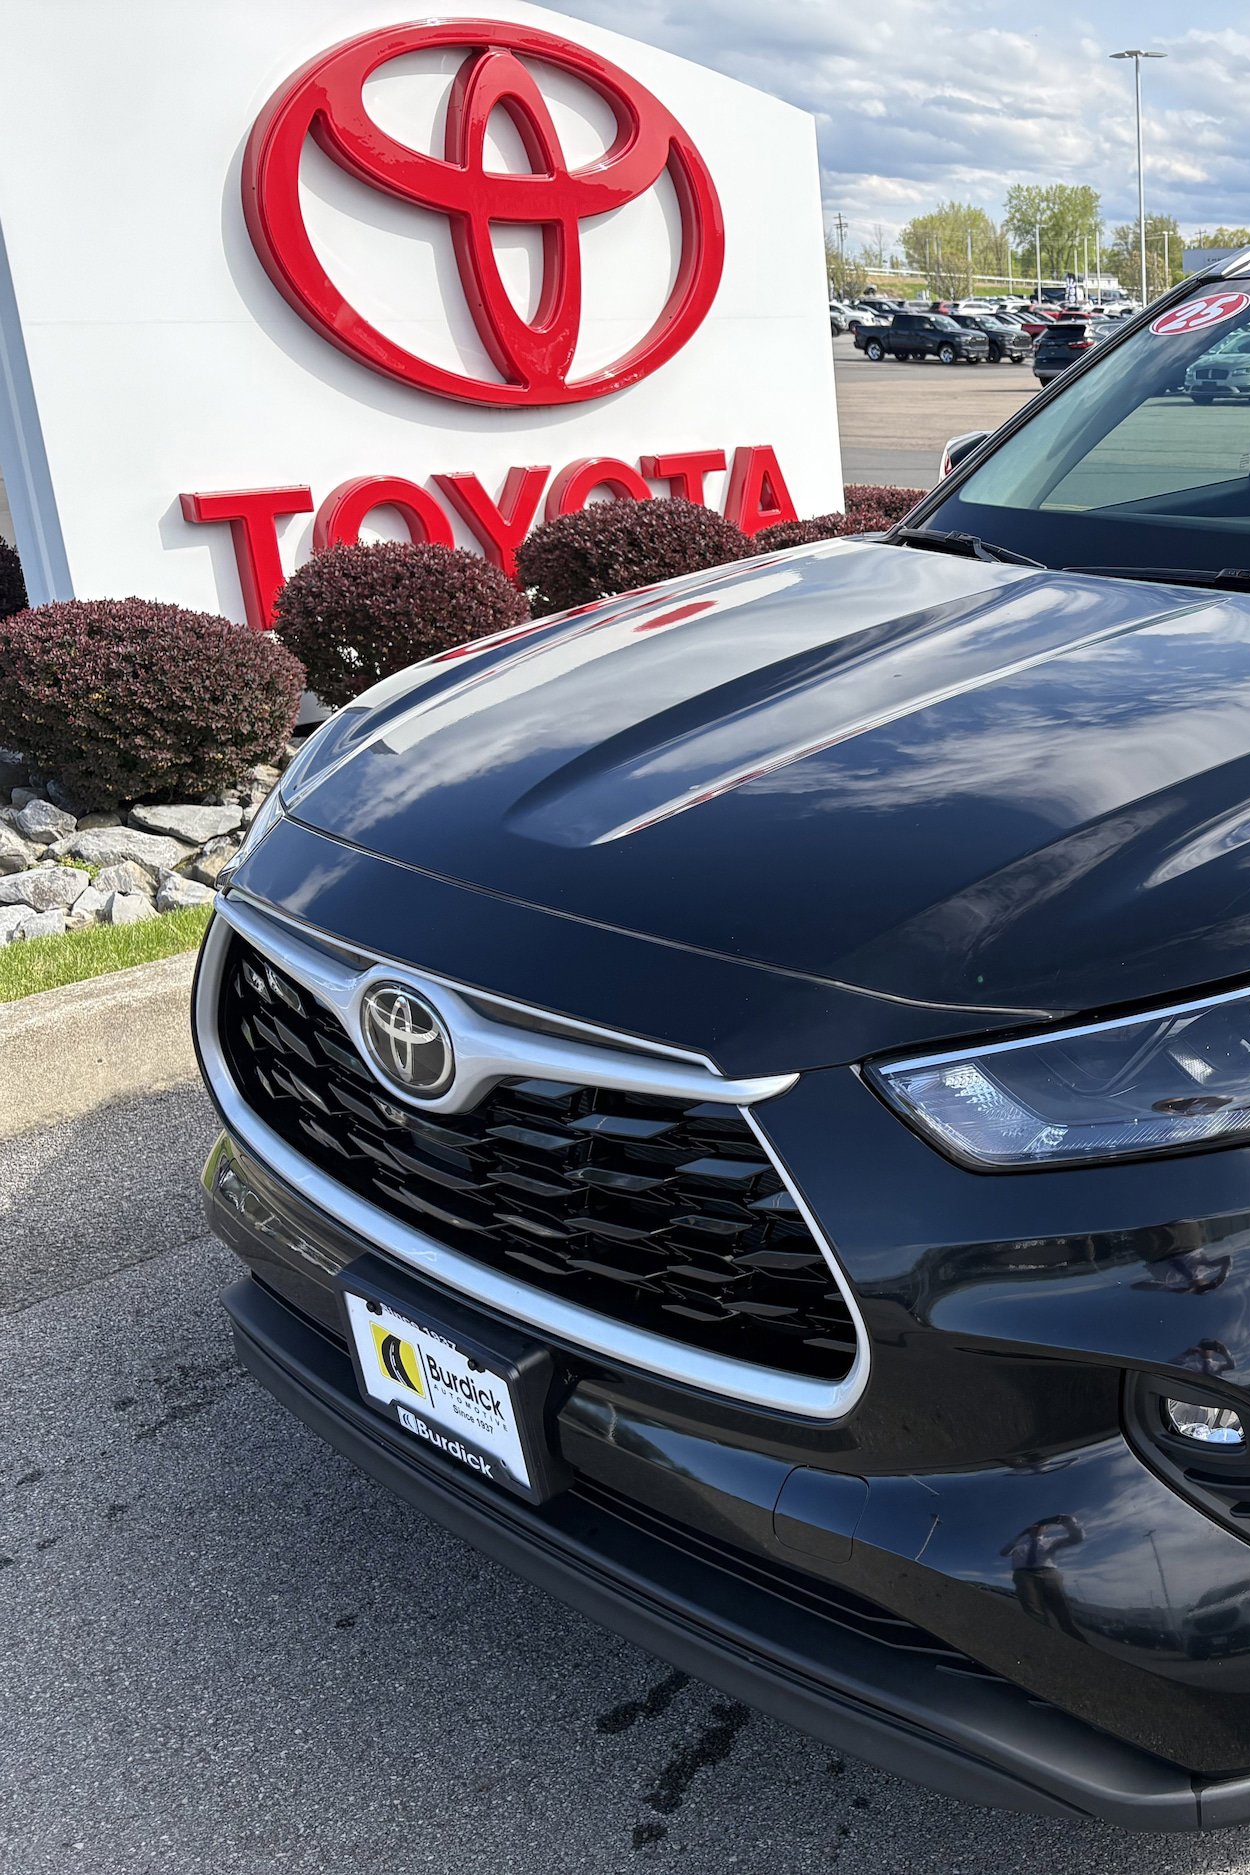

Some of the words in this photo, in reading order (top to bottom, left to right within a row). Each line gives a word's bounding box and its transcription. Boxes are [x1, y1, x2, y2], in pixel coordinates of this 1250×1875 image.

[1158, 294, 1239, 333] 25
[426, 1354, 505, 1421] Burdick
[434, 1385, 508, 1432] AUTOMOTIVE
[452, 1405, 475, 1424] Since
[476, 1417, 495, 1435] 1937
[416, 1419, 494, 1479] Burdick
